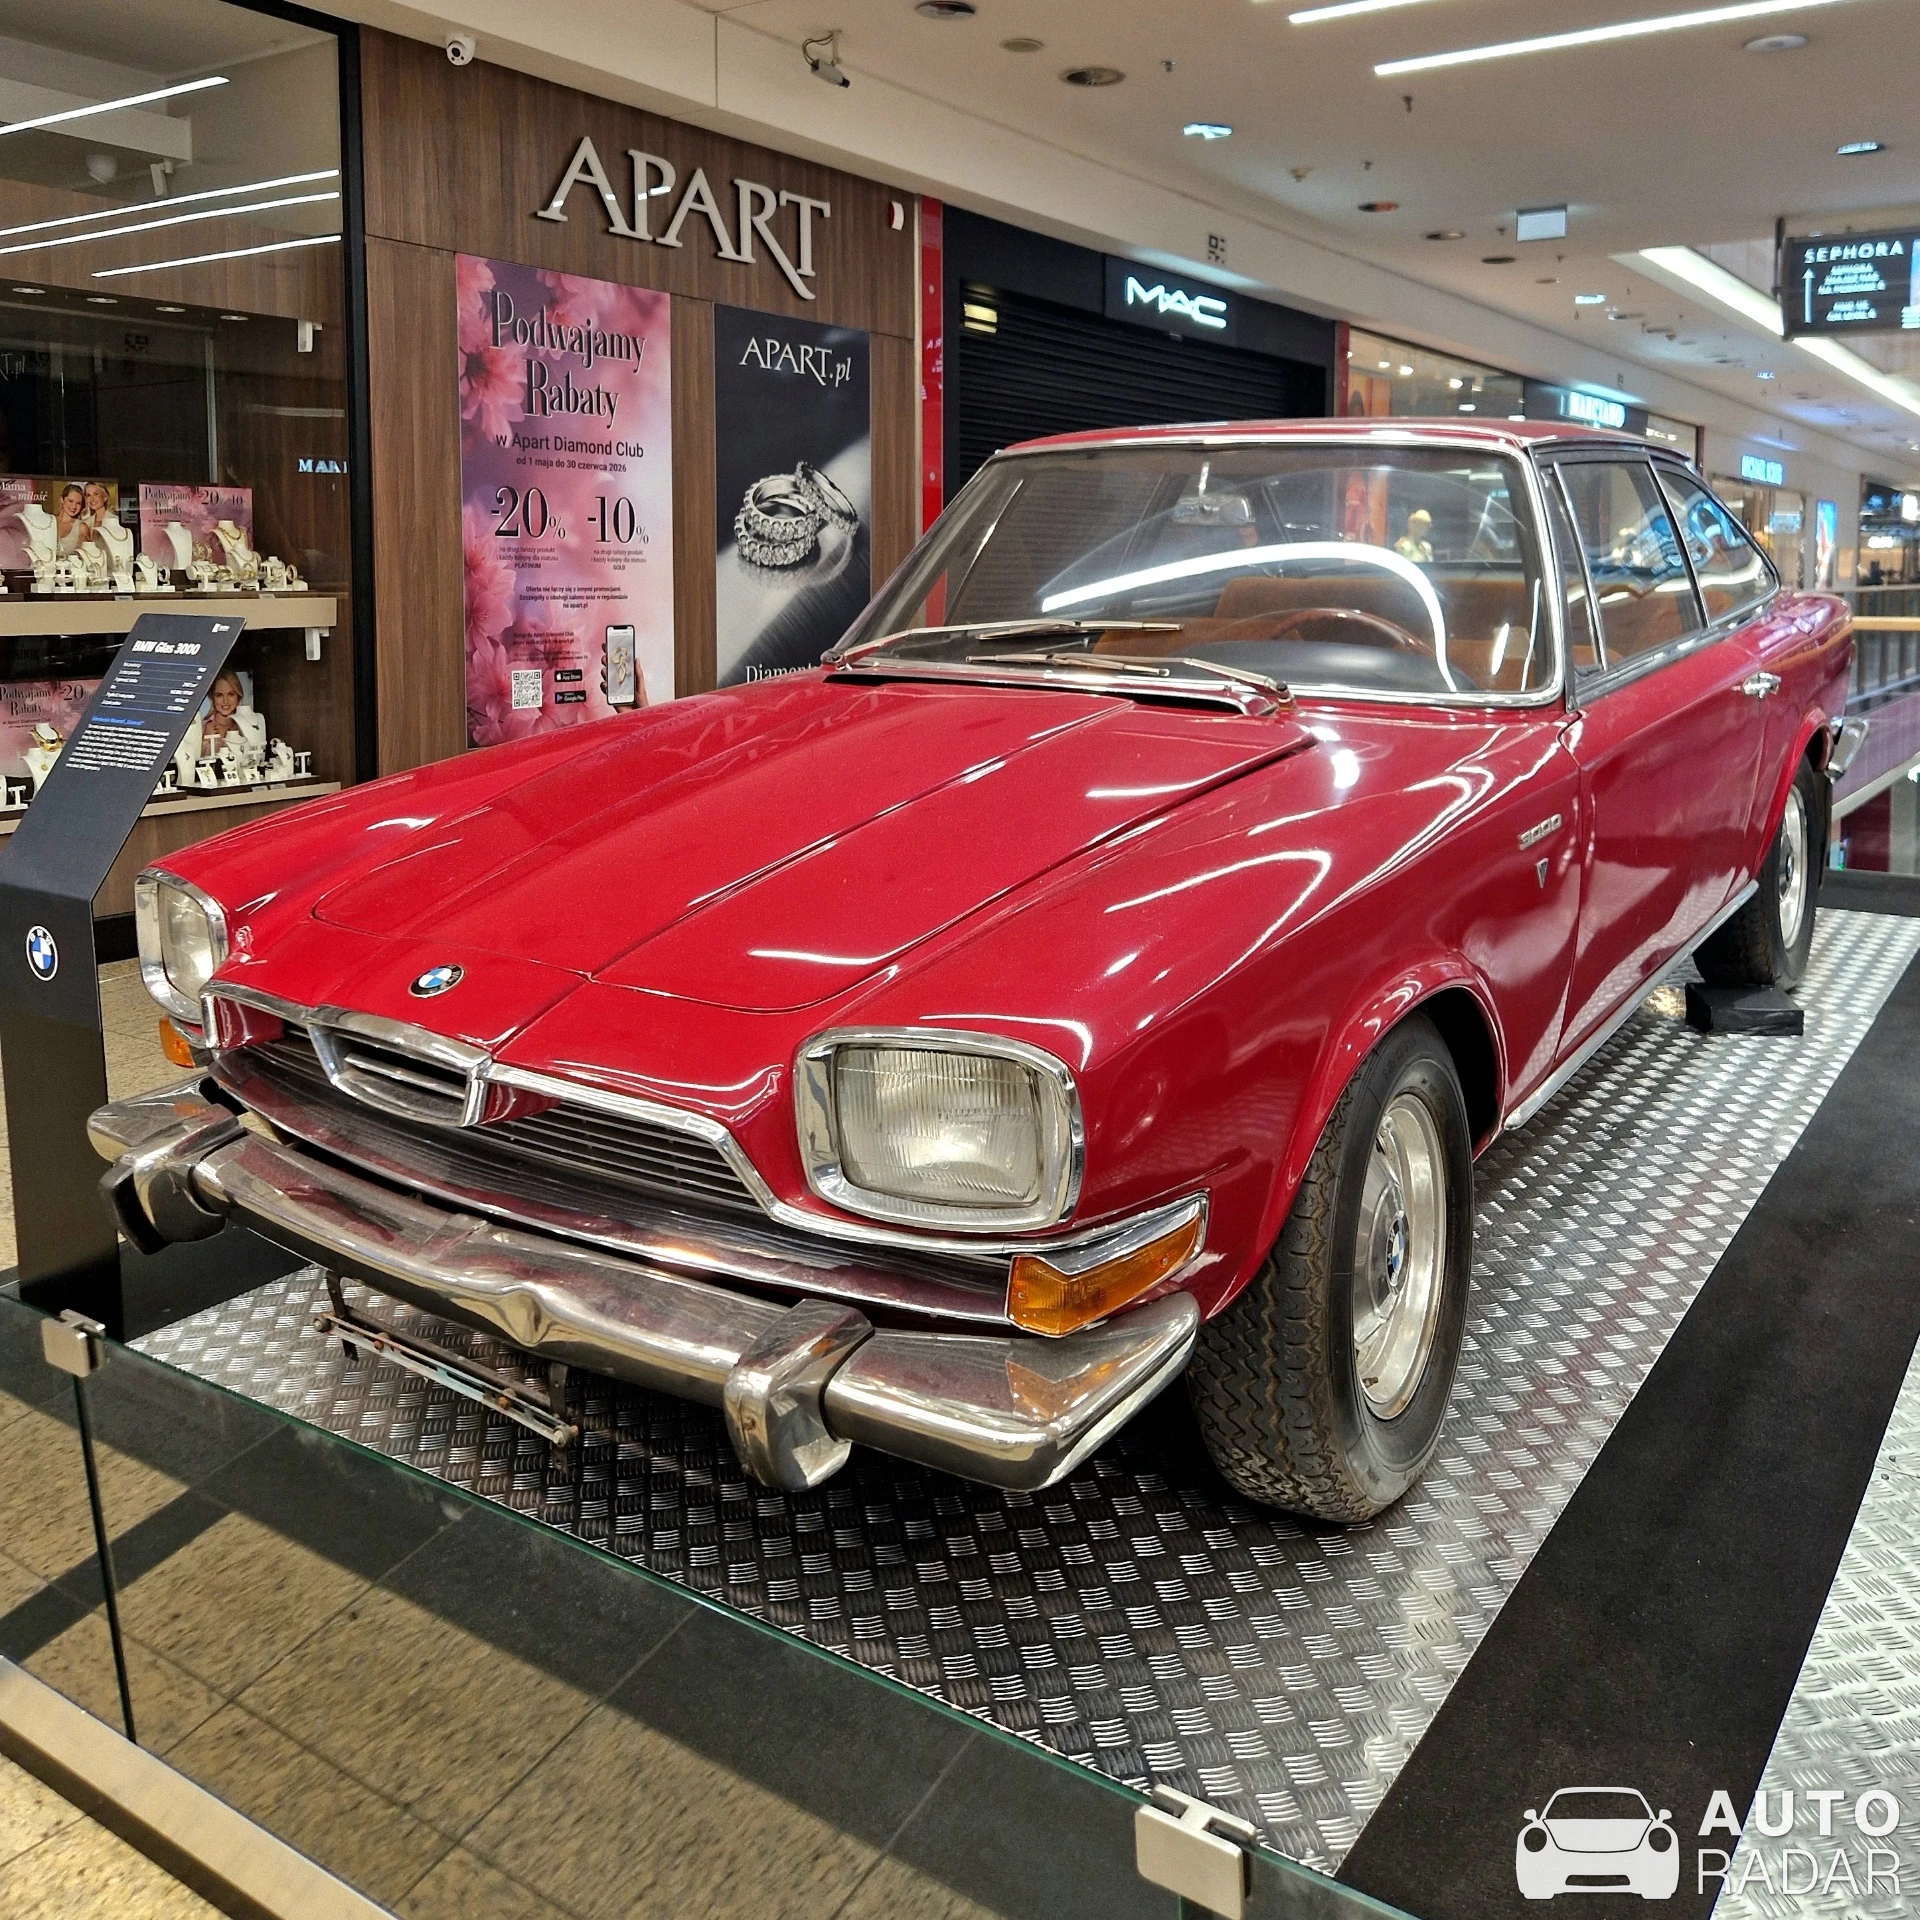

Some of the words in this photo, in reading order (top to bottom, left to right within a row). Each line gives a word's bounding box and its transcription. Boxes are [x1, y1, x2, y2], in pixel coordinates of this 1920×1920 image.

[536, 136, 831, 300] APART
[1804, 240, 1904, 264] SEPHORA
[489, 290, 648, 375] Podwajamy
[739, 336, 851, 388] APART.pl
[523, 357, 620, 429] Rabaty
[496, 434, 508, 446] w
[512, 432, 551, 452] Apart
[554, 436, 613, 455] Diamond
[616, 441, 644, 458] Club
[516, 457, 527, 466] od
[529, 457, 534, 466] 1
[535, 458, 554, 469] maja
[555, 459, 565, 468] do
[566, 460, 577, 469] 30
[578, 462, 608, 472] czerwca
[609, 462, 627, 473] 2026
[490, 486, 567, 540] -20%
[587, 495, 650, 545] -10%
[132, 640, 158, 653] BMW
[155, 642, 175, 654] Glas
[174, 642, 201, 656] 3000
[746, 663, 819, 684] Diam
